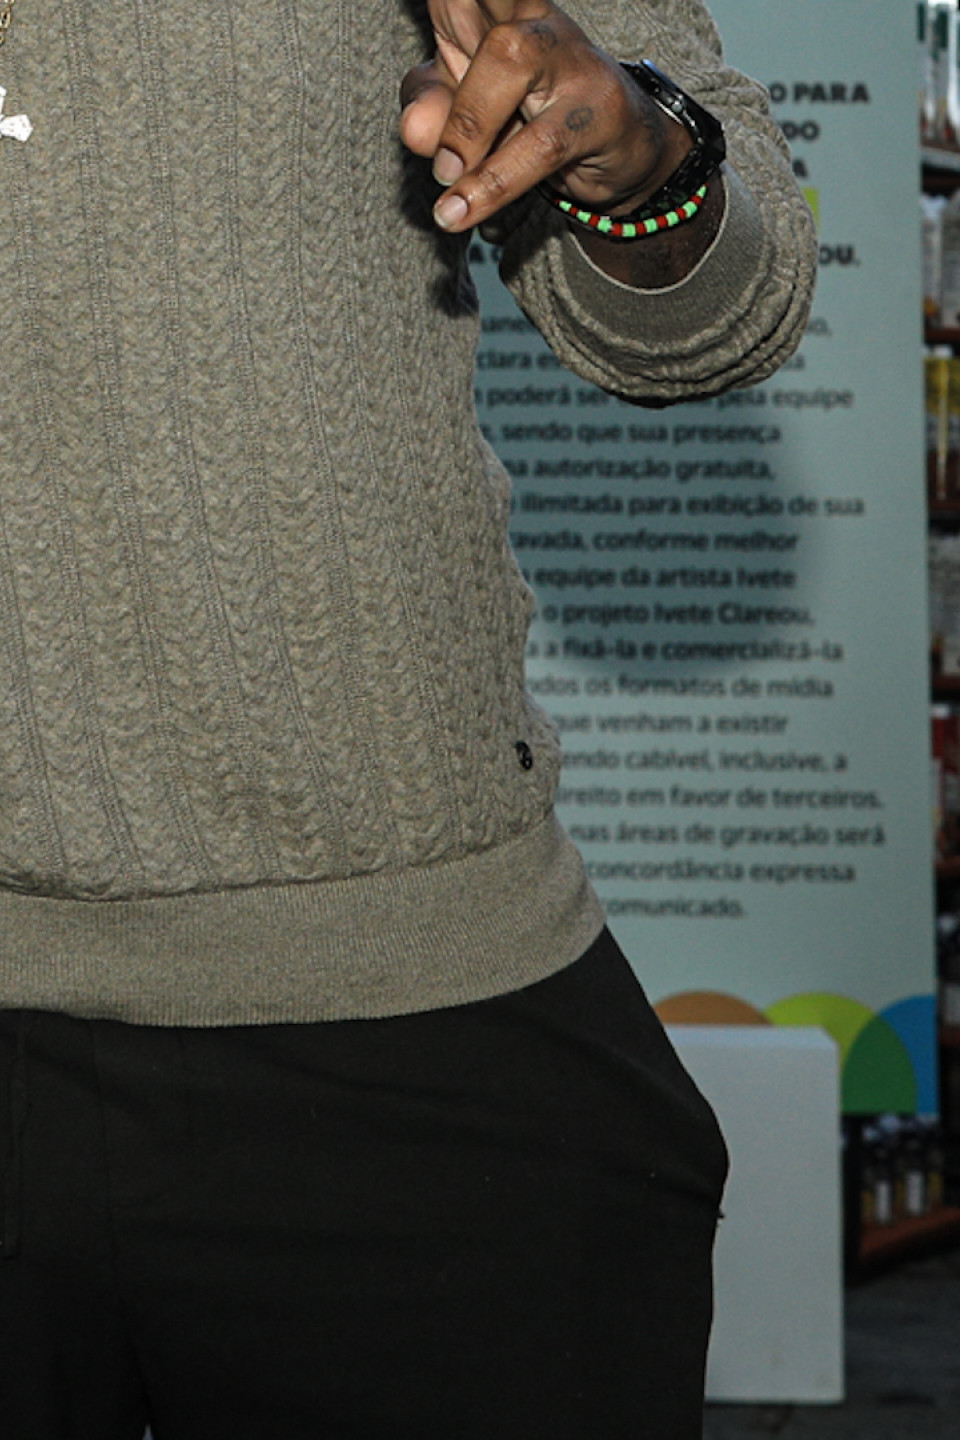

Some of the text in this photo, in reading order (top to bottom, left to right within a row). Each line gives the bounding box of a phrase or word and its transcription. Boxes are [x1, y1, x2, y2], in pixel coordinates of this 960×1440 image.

[793, 82, 871, 104] PARA
[772, 387, 855, 411] equipe
[501, 421, 573, 442] sendo
[577, 425, 623, 447] que
[627, 426, 669, 442] sua
[672, 425, 781, 447] presença
[627, 497, 682, 517] para
[787, 495, 818, 516] de
[822, 497, 864, 516] sua
[591, 529, 709, 552] conforme
[713, 531, 800, 552] melhor
[534, 566, 617, 590] equipe
[620, 565, 651, 588] da
[654, 565, 732, 588] artista
[562, 603, 650, 628] projeto
[641, 641, 658, 660] e
[583, 678, 612, 696] os
[617, 673, 727, 698] formatos
[730, 676, 762, 698] de
[596, 712, 693, 734] venham
[695, 716, 712, 734] a
[715, 713, 789, 736] existir
[832, 752, 848, 773] a
[625, 788, 665, 808] em
[669, 784, 730, 808] favor
[734, 786, 768, 809] de
[682, 823, 715, 845] de
[719, 824, 830, 851] gravação
[834, 823, 886, 847] será
[749, 862, 856, 886] expressa
